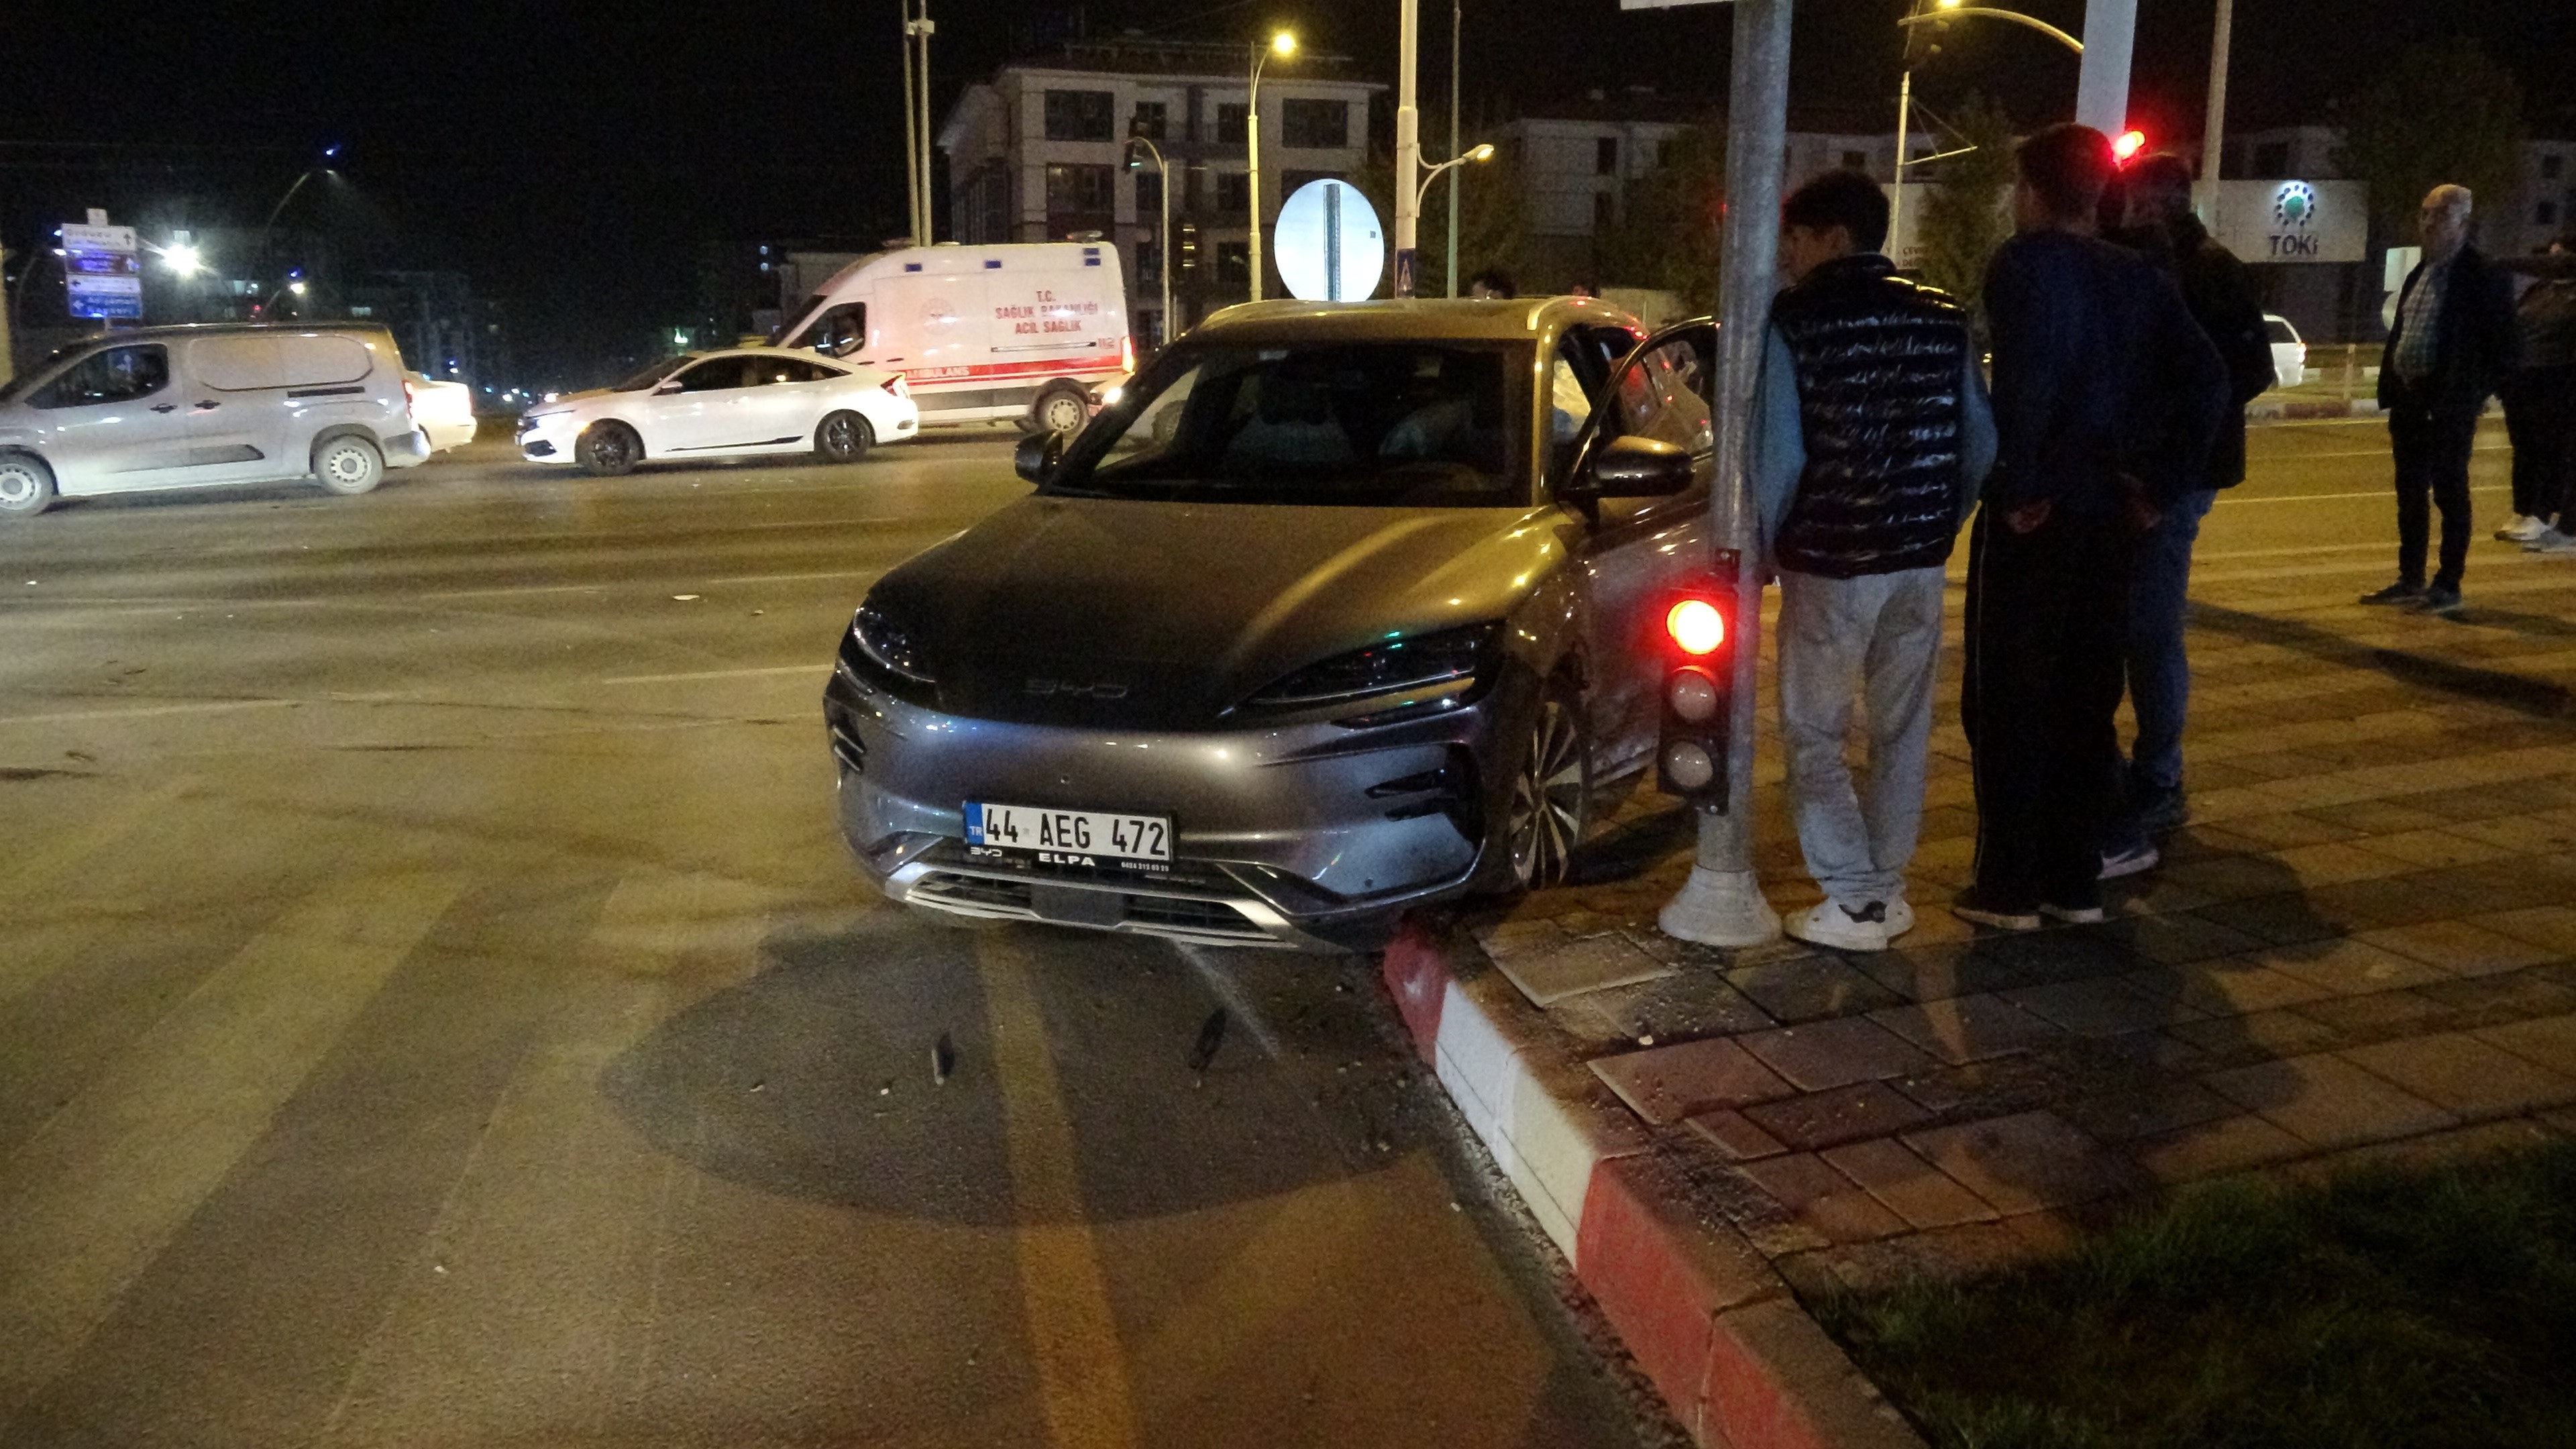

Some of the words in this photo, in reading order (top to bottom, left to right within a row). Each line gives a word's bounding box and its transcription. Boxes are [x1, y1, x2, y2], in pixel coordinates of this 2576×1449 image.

[1036, 290, 1056, 302] T.C.
[995, 305, 1034, 319] SAĞLIK
[1043, 318, 1081, 333] SAĞLIK
[1097, 337, 1115, 350] 112
[969, 826, 983, 836] TR
[985, 808, 1018, 843] 44
[1040, 813, 1091, 849] AEG
[1112, 818, 1166, 856] 472
[970, 847, 1003, 857] BYD
[1038, 853, 1096, 867] ELPA
